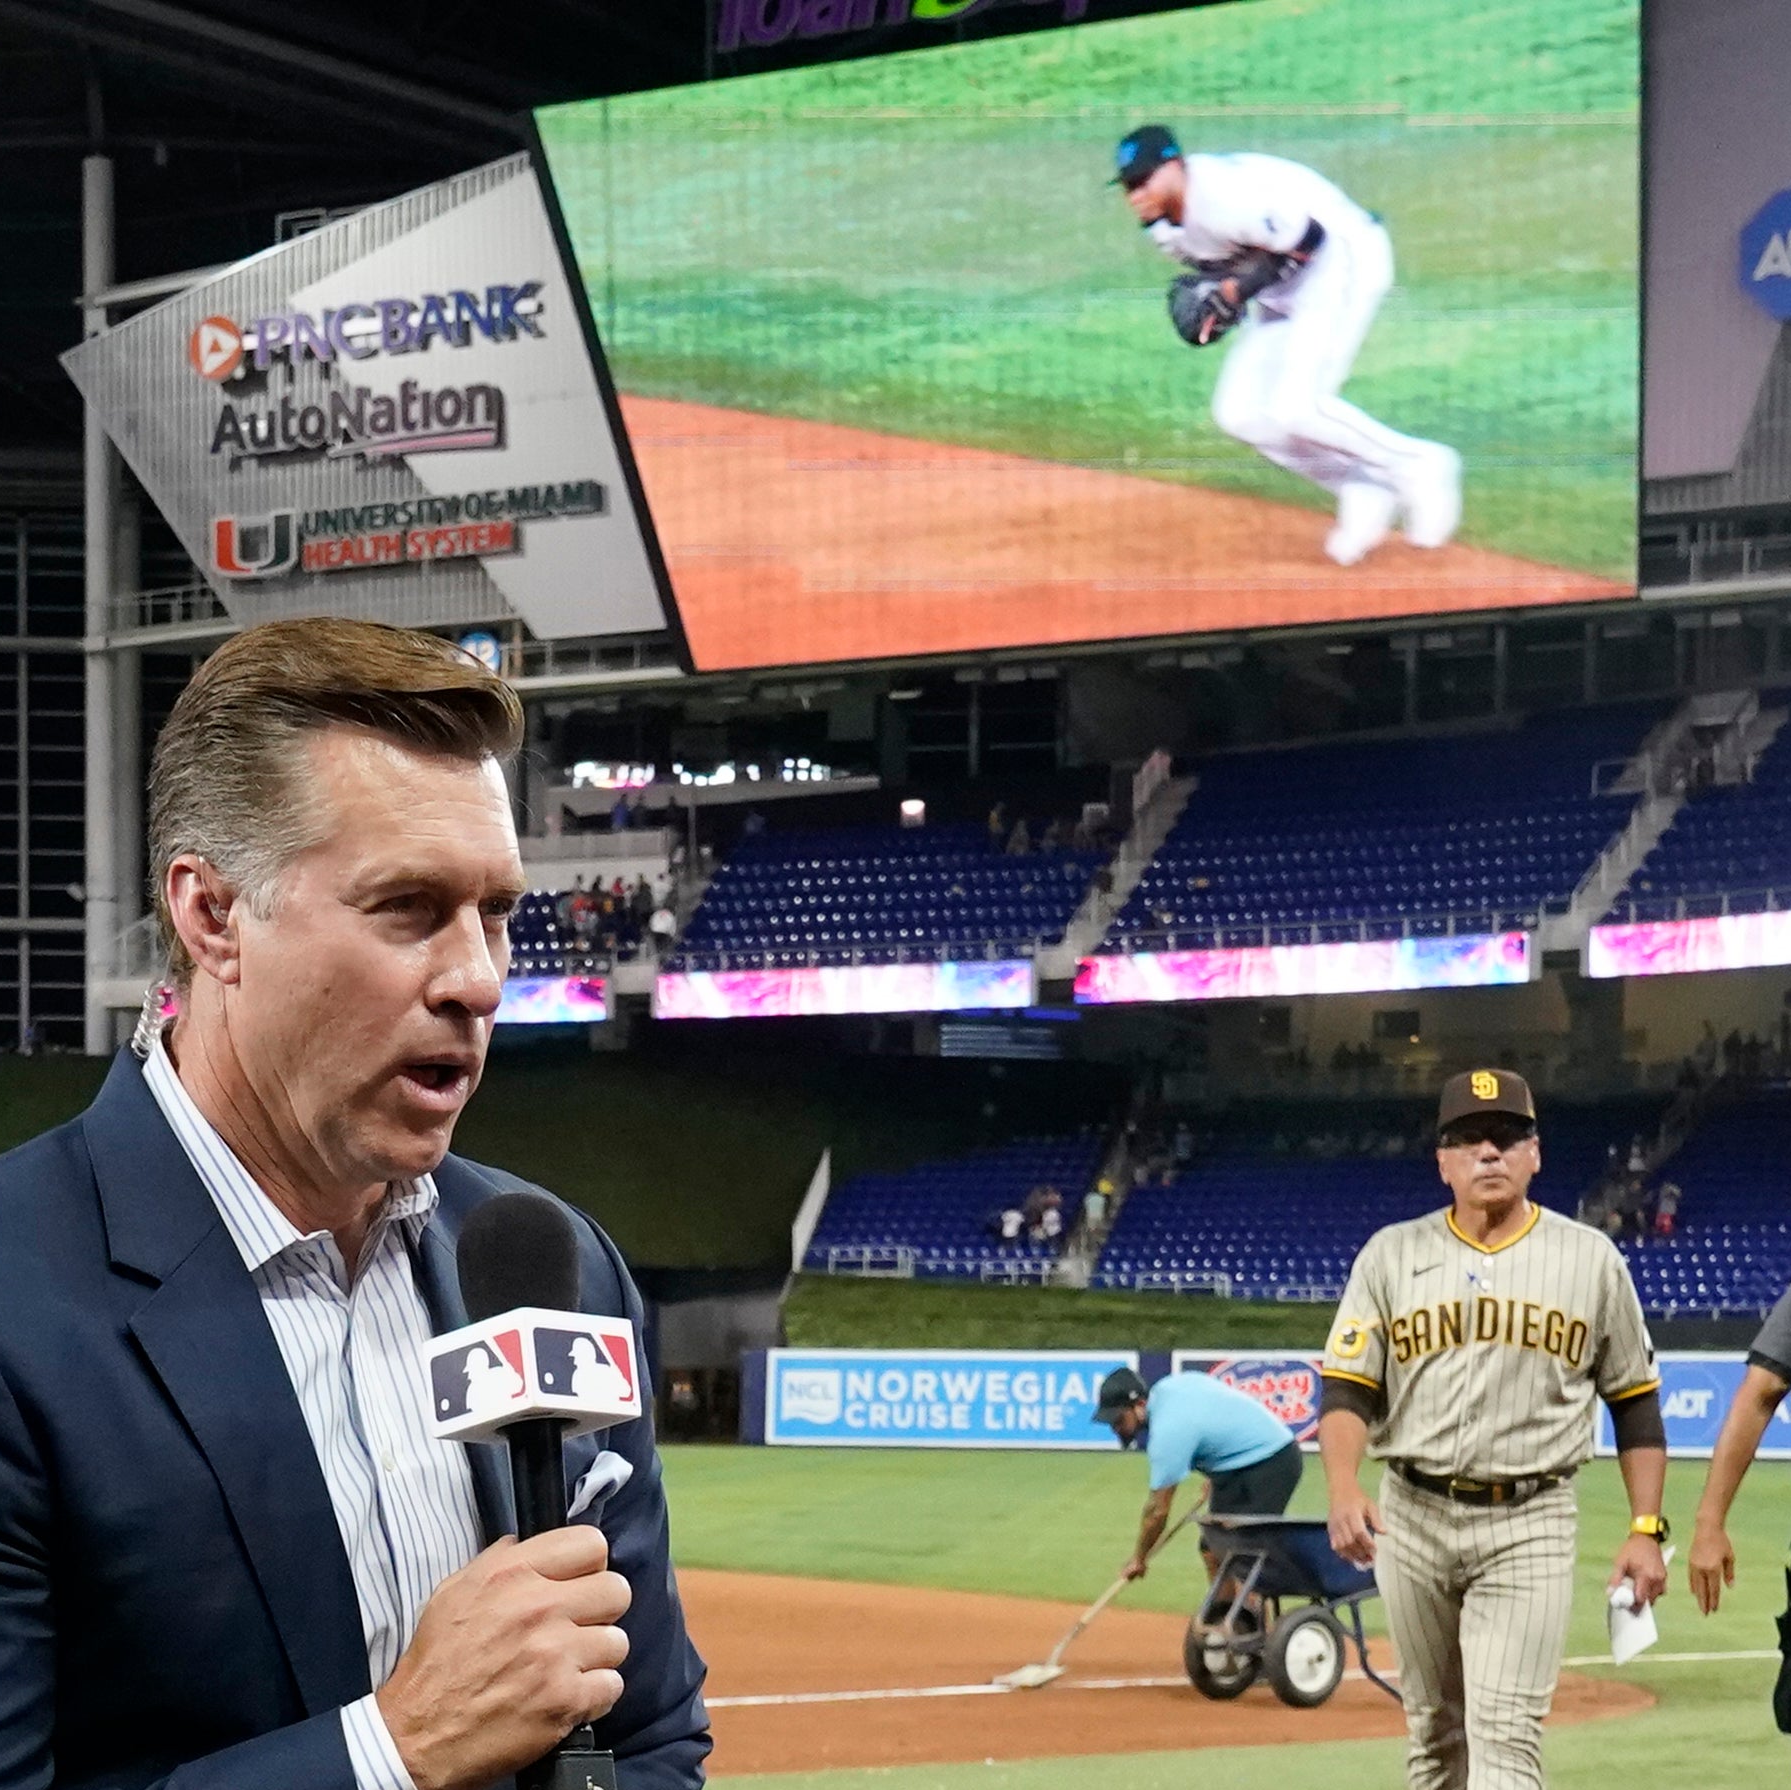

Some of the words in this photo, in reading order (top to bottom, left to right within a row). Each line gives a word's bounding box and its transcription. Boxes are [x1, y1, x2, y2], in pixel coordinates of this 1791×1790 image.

[211, 378, 498, 455] AutoNation
[304, 495, 459, 534] UNIVERSITY
[465, 490, 504, 520] OF
[508, 480, 604, 517] MIAMI
[302, 534, 402, 570] HEALTH
[407, 521, 515, 560] SYSTEM
[1471, 1070, 1499, 1101] SD
[1390, 1301, 1463, 1365] SAN
[1474, 1297, 1588, 1371] DIEGO
[843, 1404, 971, 1430] CRUISE
[983, 1405, 1065, 1431] LINE
[1660, 1388, 1714, 1419] ADT
